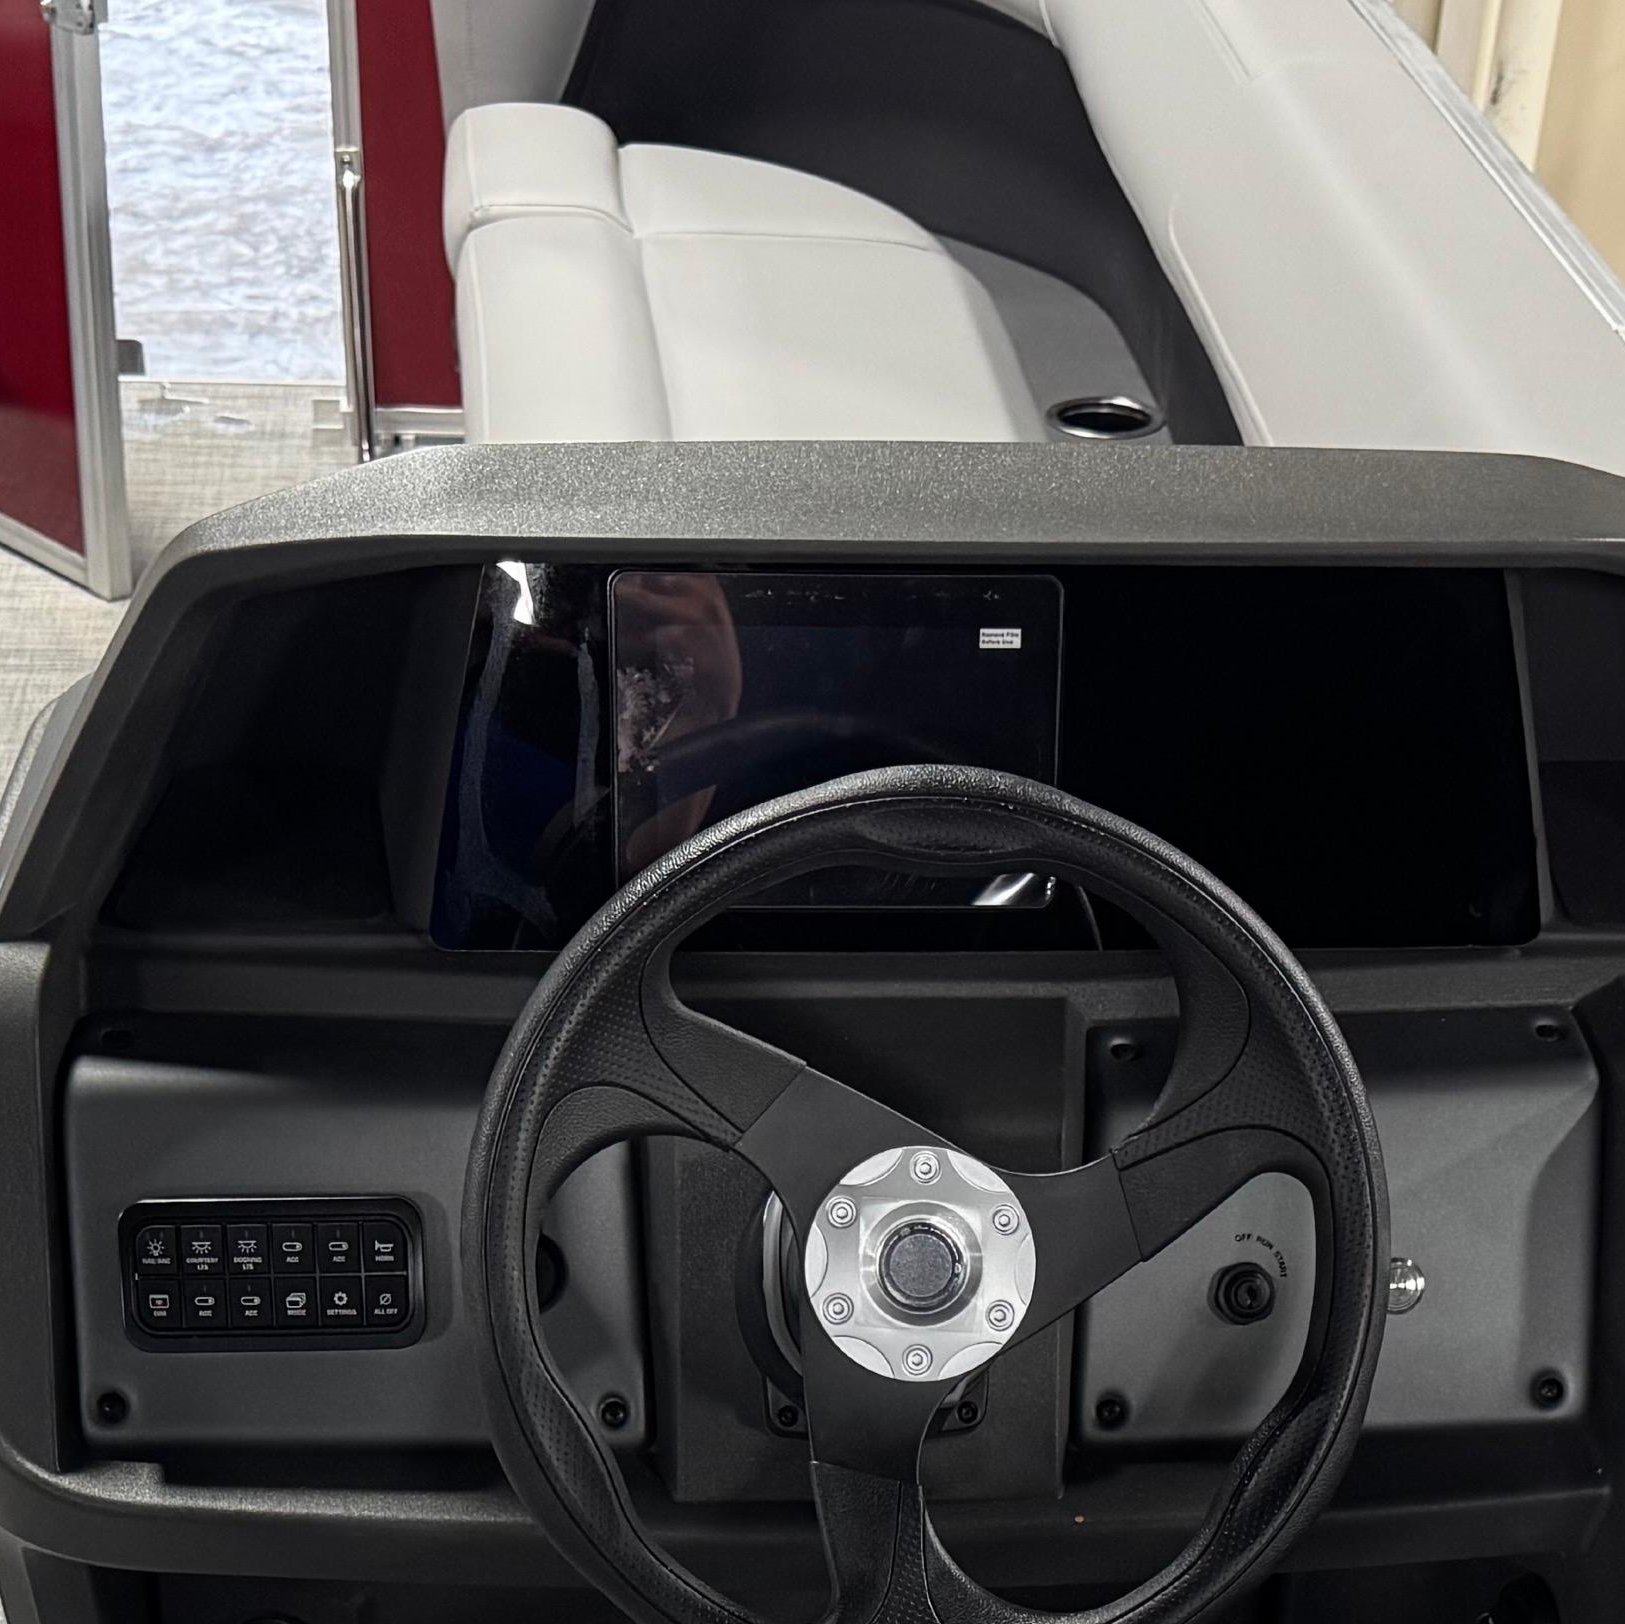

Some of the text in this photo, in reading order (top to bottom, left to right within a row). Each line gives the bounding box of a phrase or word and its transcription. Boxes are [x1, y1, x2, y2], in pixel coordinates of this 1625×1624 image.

[1235, 1233, 1287, 1277] OFF RUN START
